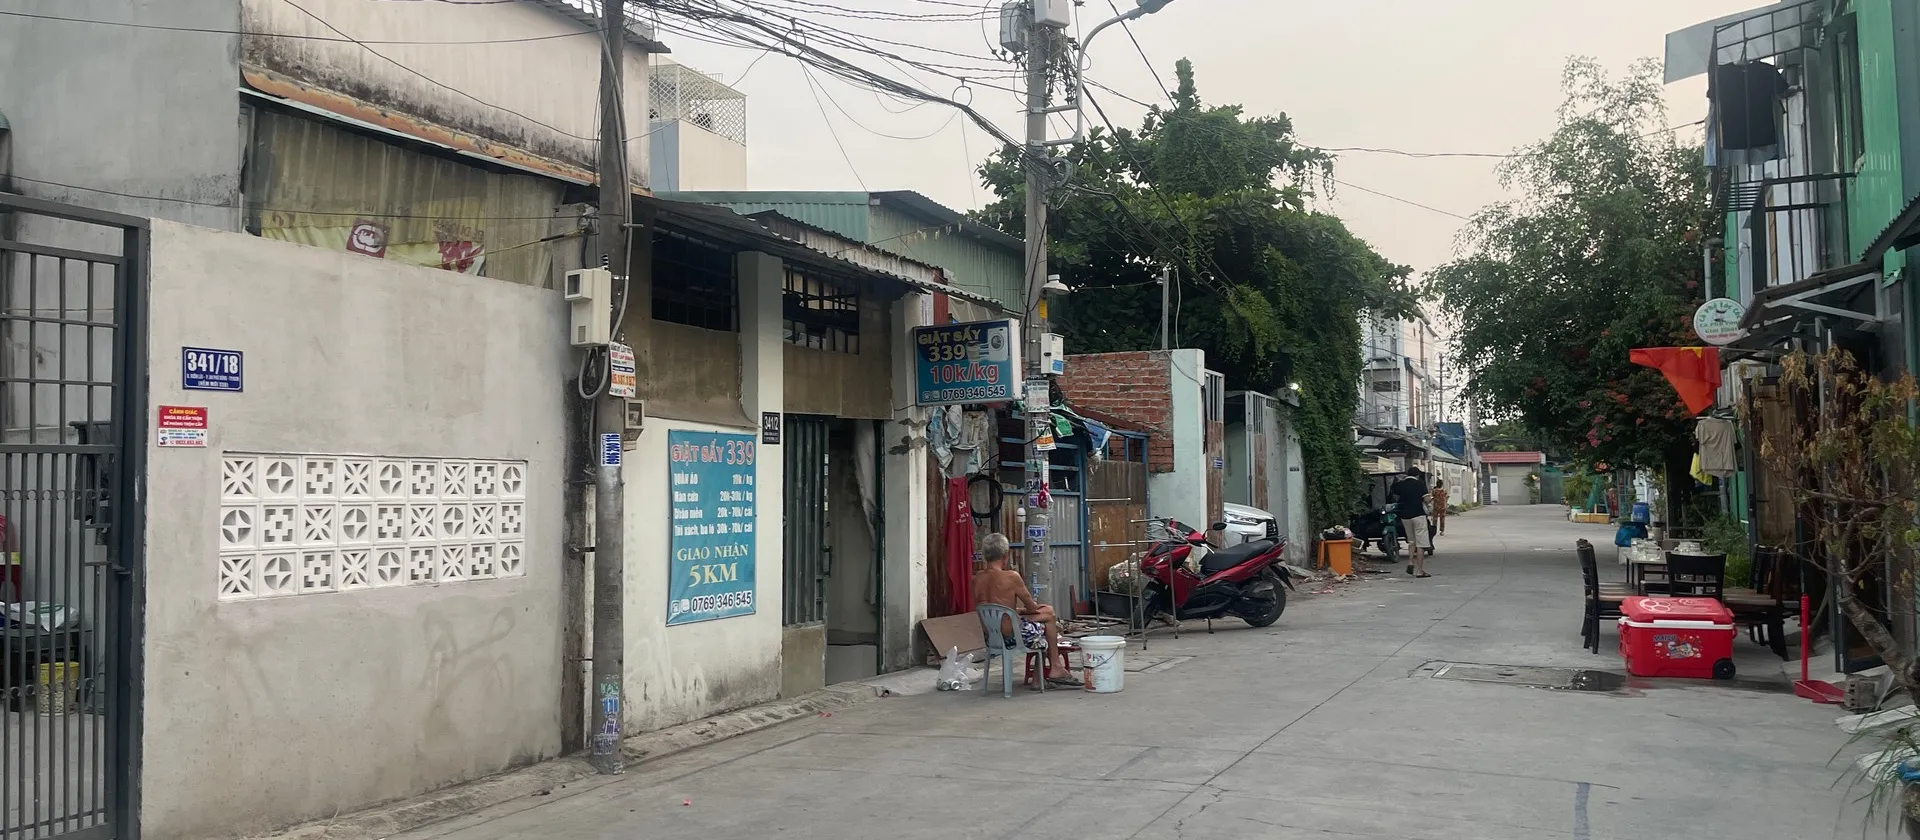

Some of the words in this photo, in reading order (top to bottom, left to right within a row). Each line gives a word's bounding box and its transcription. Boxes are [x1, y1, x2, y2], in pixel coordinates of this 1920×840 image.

[918, 330, 950, 347] GIẶT
[953, 325, 981, 341] SẤY
[187, 352, 239, 375] 341/18
[928, 344, 966, 362] 339
[931, 362, 999, 384] 10k/kg
[942, 388, 965, 400] 0769
[967, 386, 985, 399] 346
[987, 385, 1005, 397] 545
[765, 416, 779, 430] 341/2
[671, 440, 699, 467] GIẶT
[701, 438, 724, 463] SẤY
[726, 440, 755, 465] 339
[676, 546, 710, 562] GIAO
[714, 541, 749, 560] NHẬN
[688, 562, 738, 588] 5KM
[691, 595, 715, 613] 0769
[717, 592, 734, 610] 346
[735, 590, 753, 607] 545
